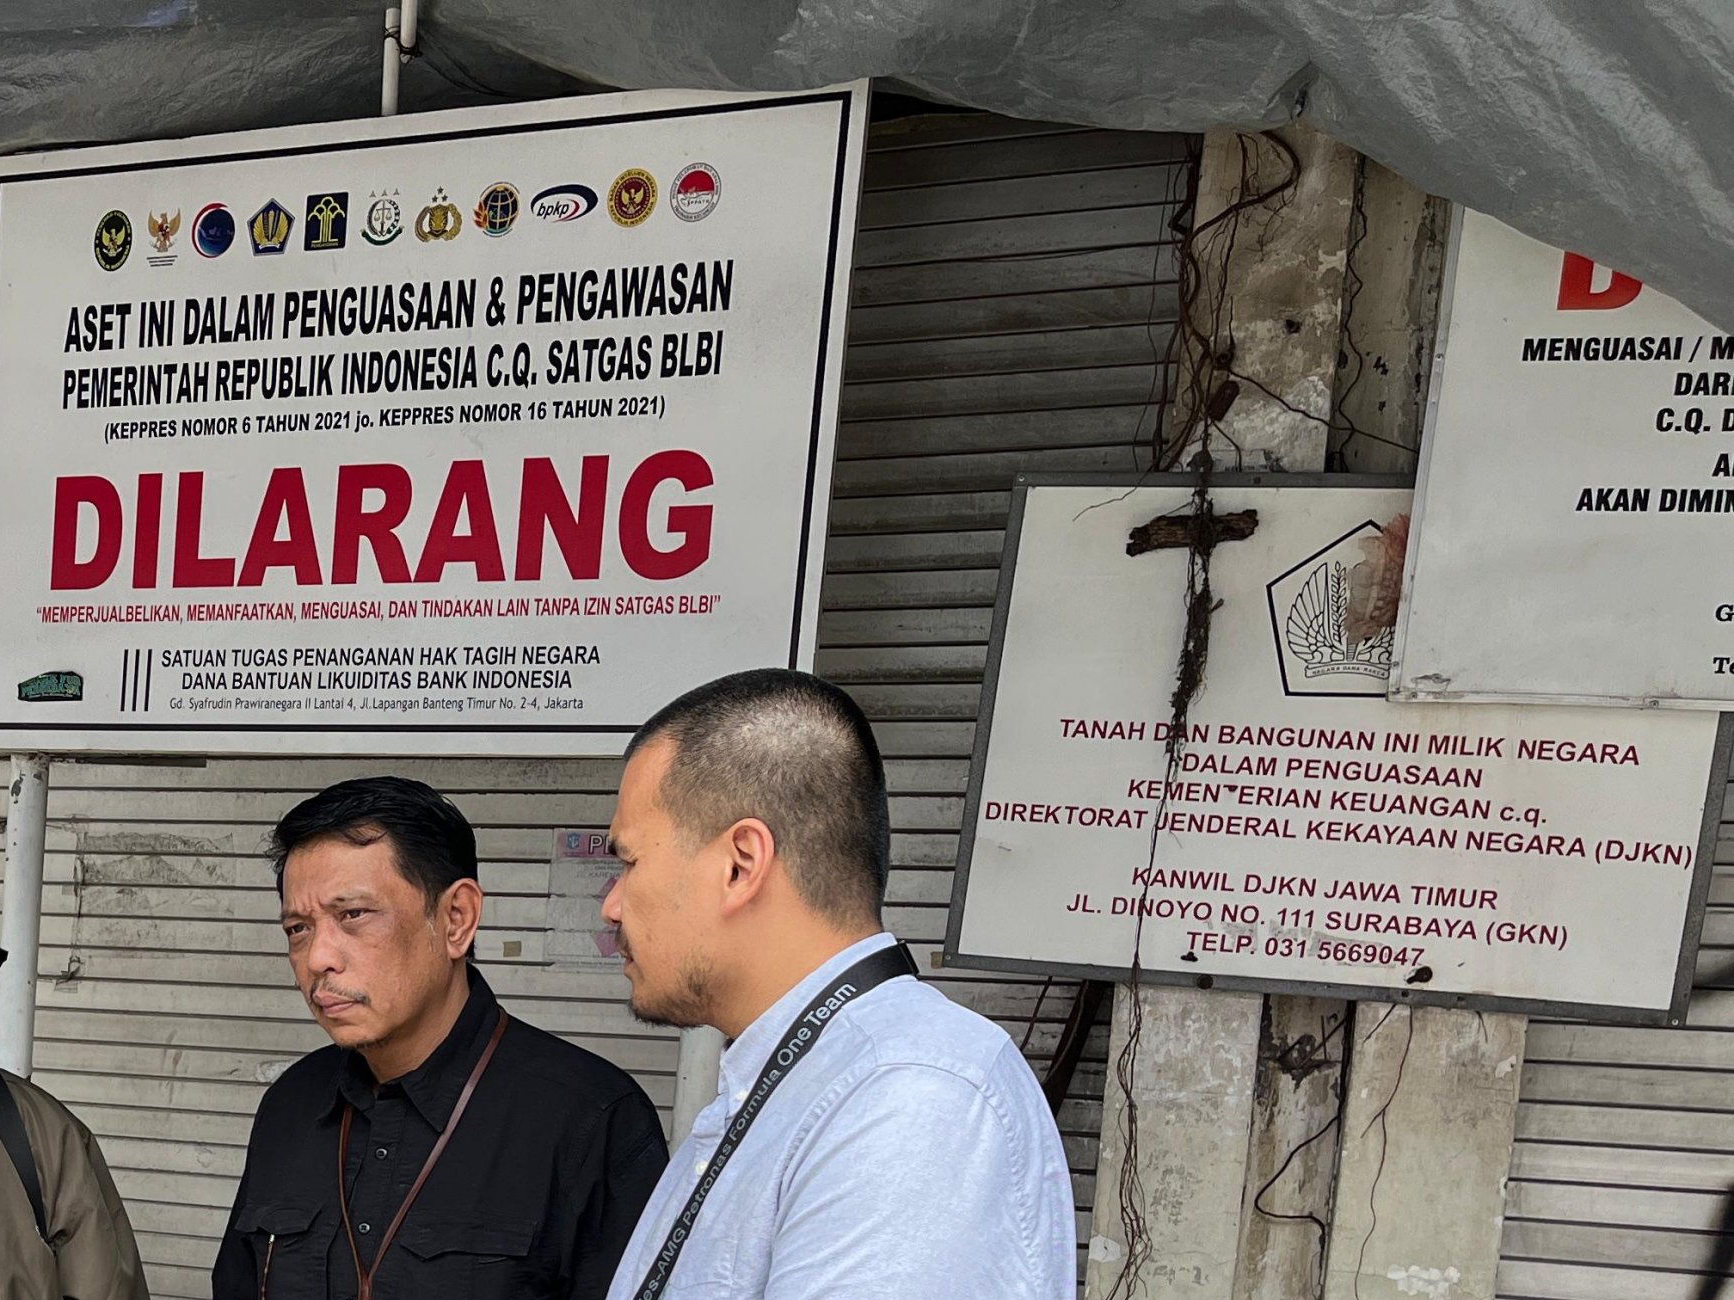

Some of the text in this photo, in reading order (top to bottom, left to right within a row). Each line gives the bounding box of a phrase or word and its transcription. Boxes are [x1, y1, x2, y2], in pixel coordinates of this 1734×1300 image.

[537, 201, 570, 220] bpkp
[64, 260, 733, 352] ASET INI DALAM PENGUASAAN & PENGAWASAN
[1522, 337, 1683, 361] MENGUASAI
[1710, 336, 1733, 360] M
[63, 331, 723, 409] PEMERINTAH REPUBLIK INDONESIA C.Q. SATGAS BLBI
[105, 396, 665, 444] (KEPPRES NOMOR 6 TAHUN 2021 jo. KEPPRES NOMOR 16 TAHUN 2021)
[1657, 408, 1710, 434] C.Q.
[1576, 488, 1650, 511] AKAN
[51, 450, 713, 590] DILARANG
[187, 603, 297, 623] MEMANFAATKAN,
[301, 601, 385, 621] MENGUASAI,
[389, 601, 417, 618] DAN
[422, 600, 493, 617] TINDAKAN
[498, 599, 529, 616] LAIN
[535, 598, 579, 616] TANPA
[584, 598, 610, 615] IZIN
[615, 596, 673, 615] SATGAS
[162, 646, 600, 667] SATUAN TUGAS PENANGANAN HAK TAGIH NEGARA
[182, 670, 571, 689] DANA BANTUAN LIKUIDITAS BANK INDONESIA
[170, 698, 185, 710] Gd.
[189, 697, 231, 711] Syafrudin
[235, 697, 302, 713] Prawiranegara
[314, 698, 343, 709] Lantai
[423, 697, 463, 712] Banteng
[467, 697, 496, 709] Timur
[499, 698, 515, 710] No.
[545, 697, 583, 709] Jakarta
[1061, 719, 1145, 740] TANAH
[1218, 726, 1375, 750] BANGUNAN
[1384, 733, 1419, 753] INI
[1428, 735, 1504, 757] MILIK
[1518, 740, 1639, 765] NEGARA
[1182, 753, 1482, 787] DALAM PENGUASAAN
[1331, 791, 1490, 819] KEUANGAN
[1500, 807, 1546, 827] c.q.
[986, 802, 1691, 869] DIREKTORAT JENDERAL KEKAYAAN NEGARA (DJKN)
[1132, 868, 1497, 909] KANWIL DJKN JAWA TIMUR
[1067, 894, 1567, 950] JL. DINOYO NO. 111 SURABAYA (GKN)
[1187, 932, 1424, 966] TELP. 031 5669047
[683, 1142, 733, 1231] Petronas
[729, 1067, 782, 1143] Formula
[776, 1028, 812, 1068] One
[806, 981, 858, 1031] Team
